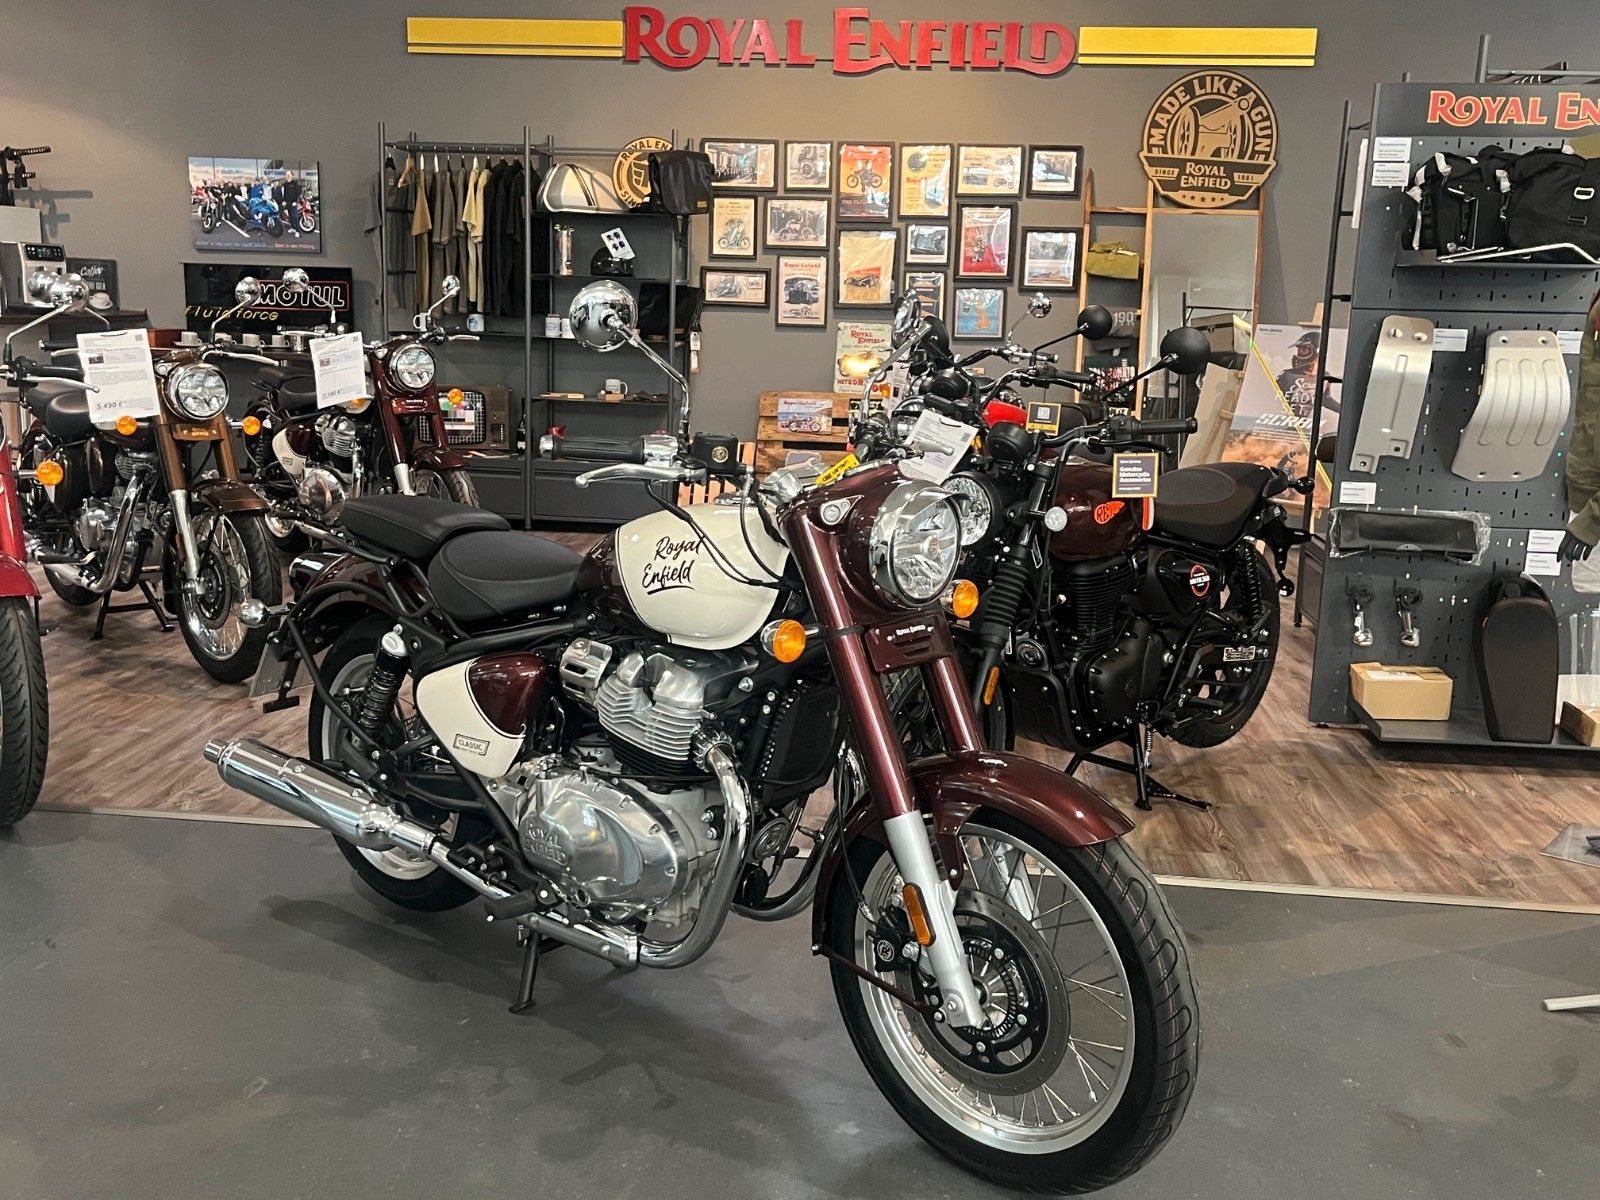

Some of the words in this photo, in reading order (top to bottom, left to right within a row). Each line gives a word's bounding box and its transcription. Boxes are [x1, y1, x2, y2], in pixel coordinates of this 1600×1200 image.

[625, 6, 816, 69] ROYAL
[833, 7, 1077, 76] ENFIELD
[1149, 86, 1190, 146] MADE
[1193, 76, 1241, 98] LIKE
[1250, 105, 1272, 152] GUN
[1427, 90, 1547, 127] ROYAL
[621, 139, 652, 161] RYAL
[1186, 162, 1226, 176] ROYAL
[1180, 175, 1231, 190] ENFIELD
[851, 330, 872, 338] ROYAL
[654, 536, 701, 560] Royal
[642, 560, 695, 588] Enfield
[458, 739, 482, 751] CLASSIC
